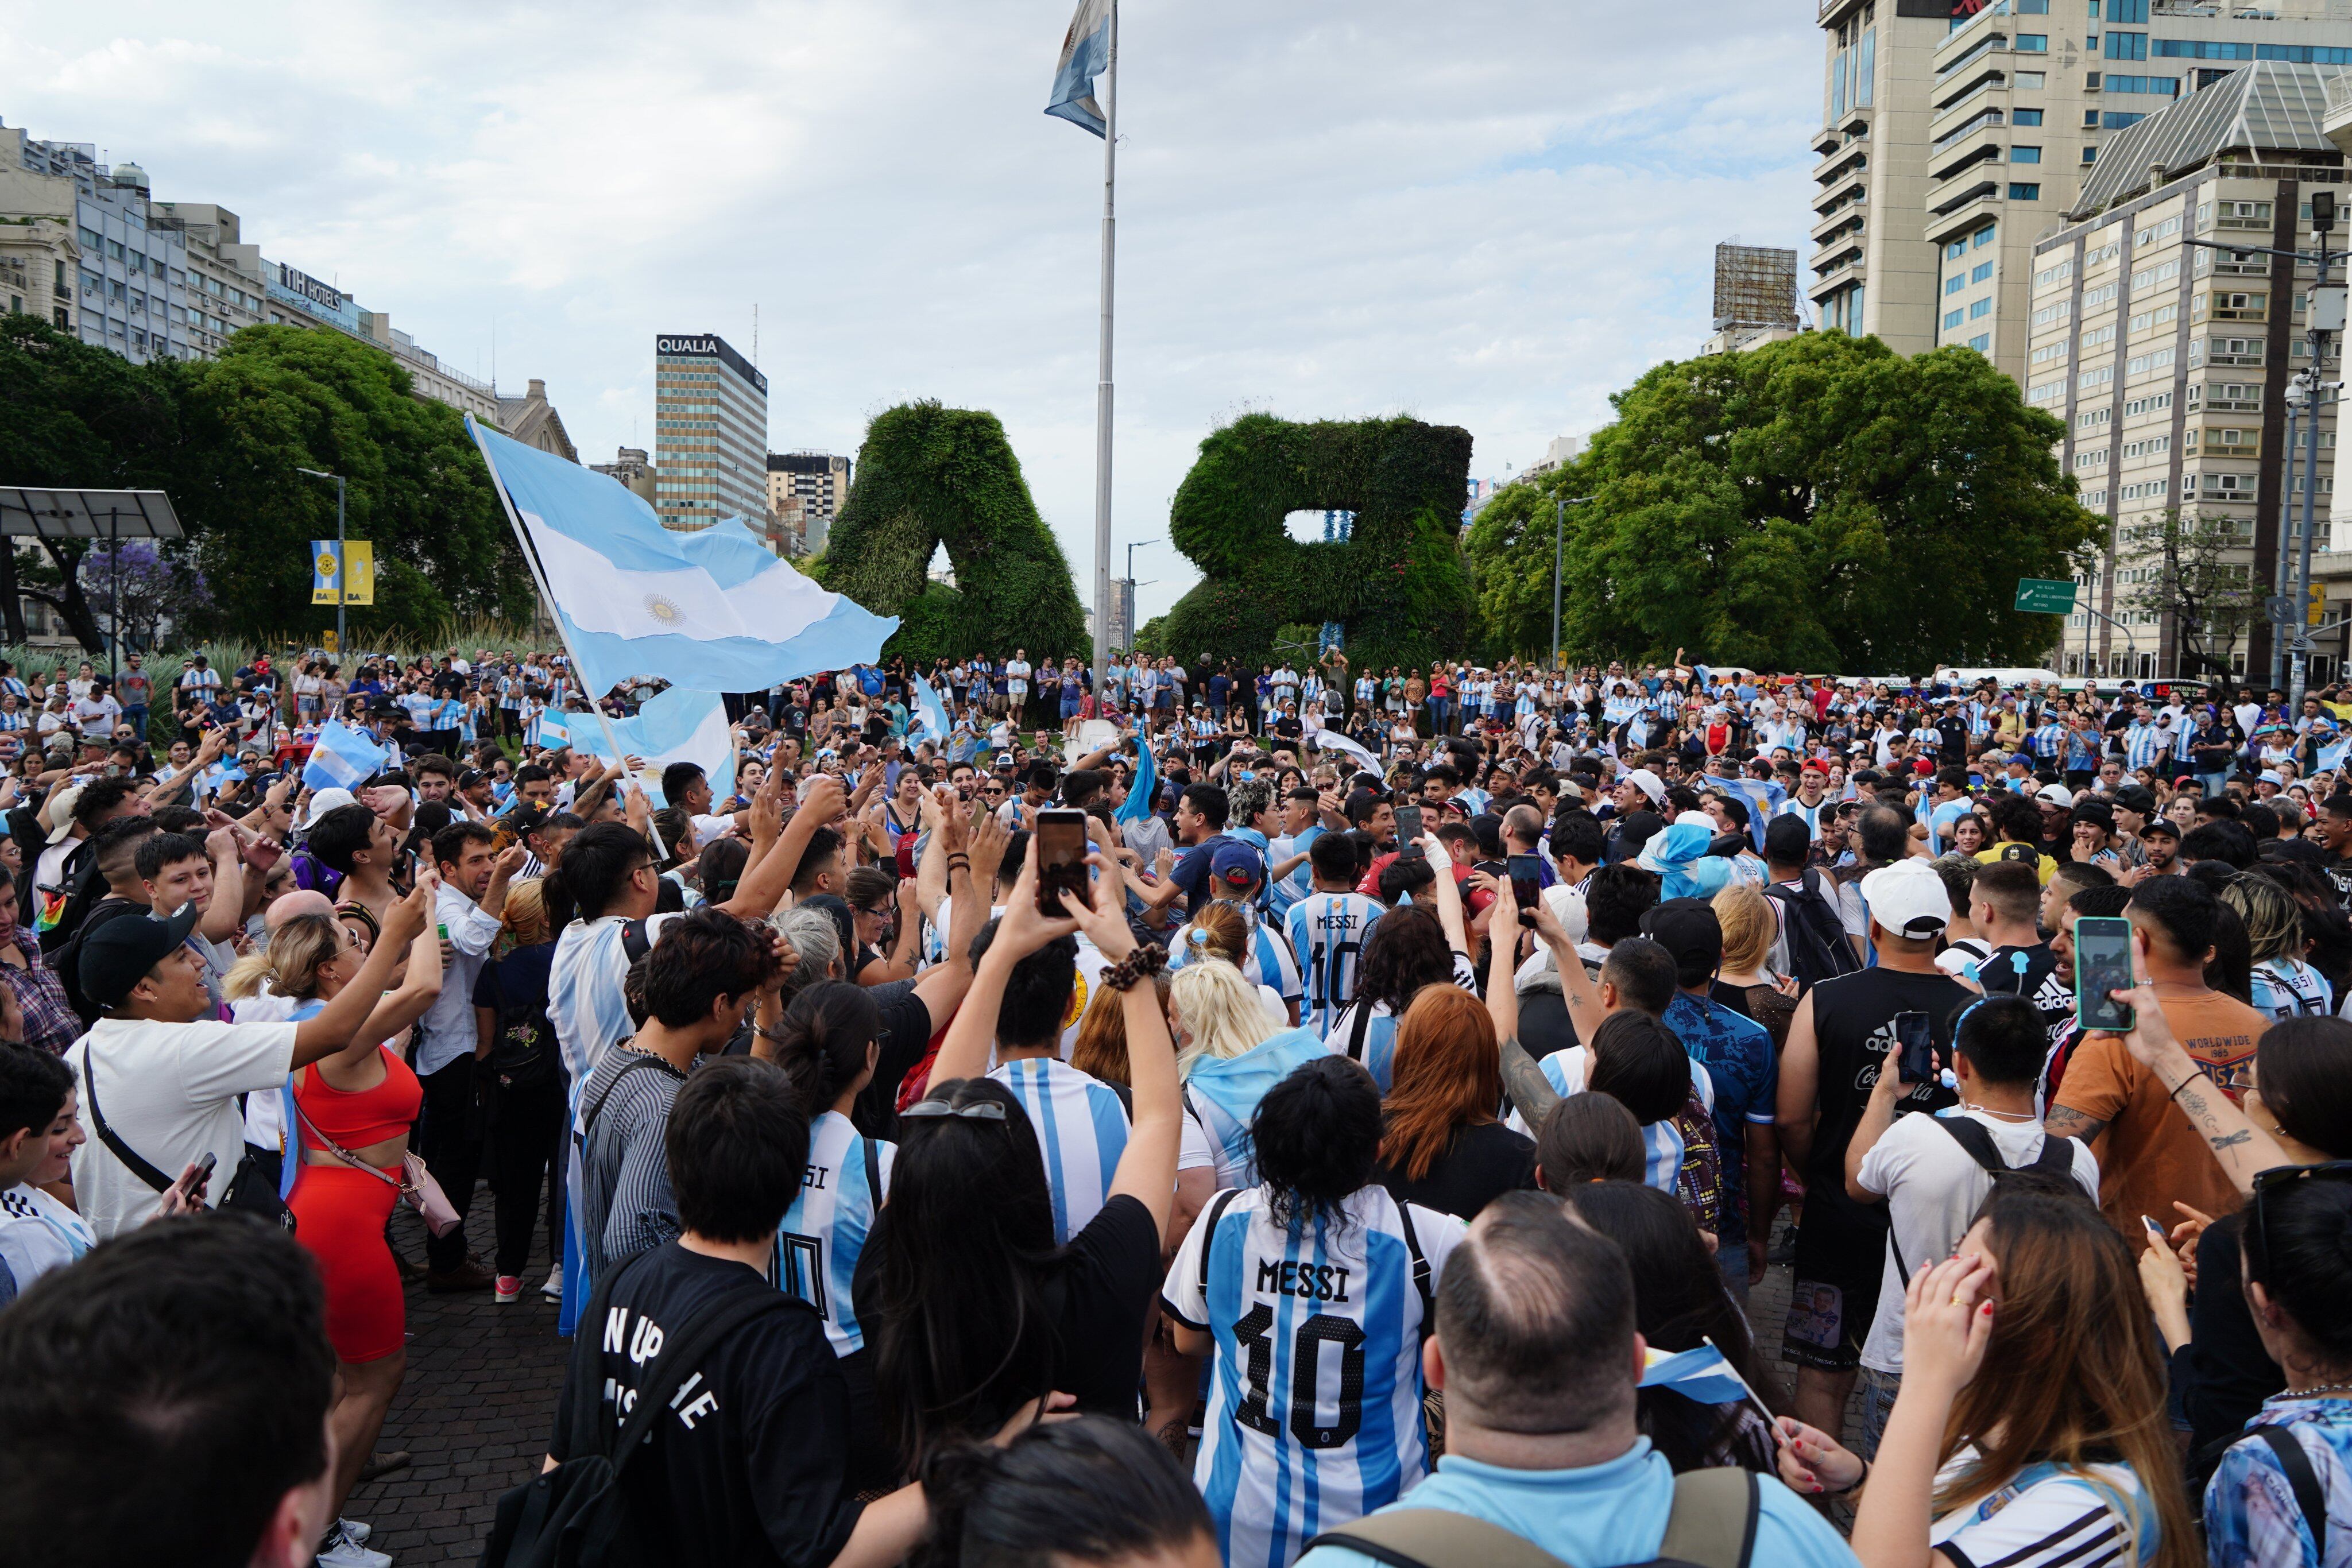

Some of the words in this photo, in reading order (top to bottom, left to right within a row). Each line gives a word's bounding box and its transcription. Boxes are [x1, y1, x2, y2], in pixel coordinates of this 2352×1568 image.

[308, 281, 341, 311] HOTELS
[658, 339, 718, 353] QUALIA
[316, 593, 328, 601] BA
[347, 593, 361, 601] BA
[1317, 915, 1358, 930] MESSI
[1311, 942, 1360, 1010] 10
[2274, 974, 2313, 995] MSSI
[2185, 1035, 2251, 1050] WORLDWIDE
[2211, 1049, 2229, 1058] 1985
[1256, 1256, 1350, 1303] MESSI
[1813, 1356, 1838, 1366] FRESCA
[1232, 1301, 1368, 1449] 10
